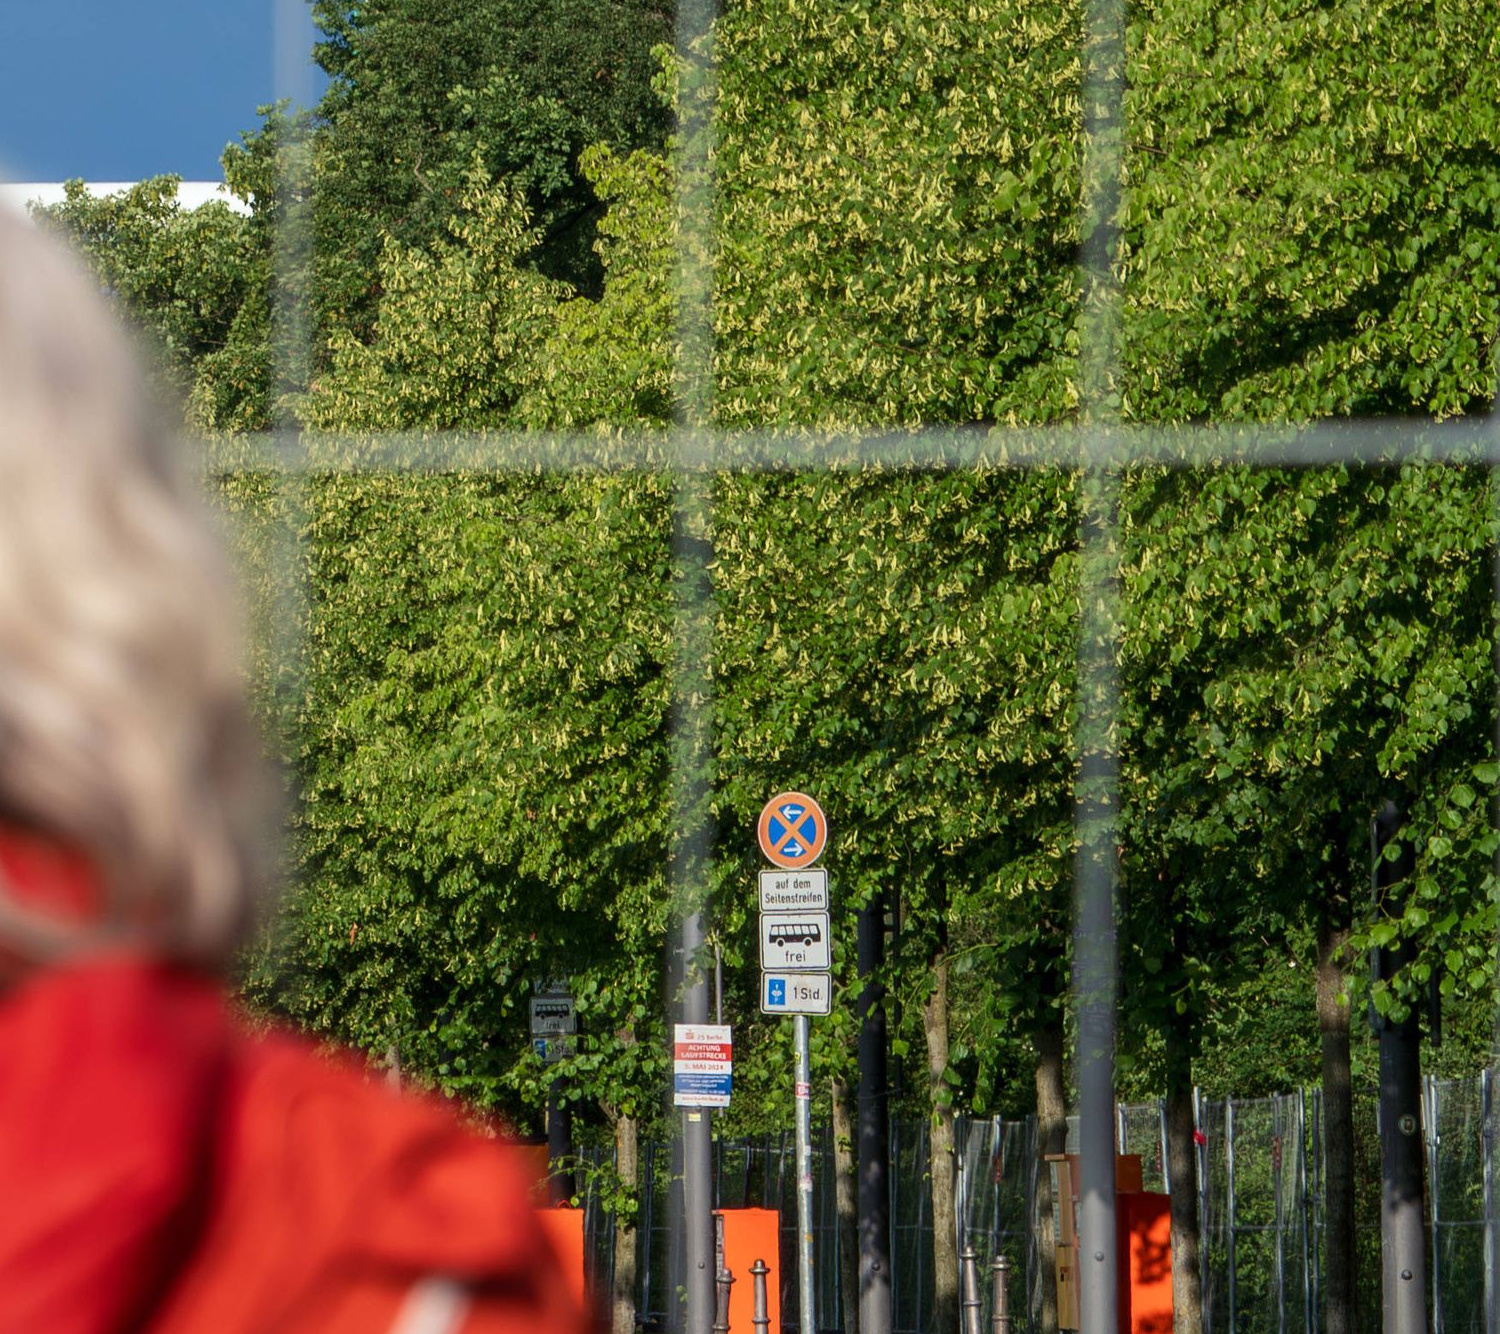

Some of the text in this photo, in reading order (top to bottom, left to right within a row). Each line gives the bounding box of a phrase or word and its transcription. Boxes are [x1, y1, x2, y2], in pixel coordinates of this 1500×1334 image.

[775, 879, 811, 889] auf dem
[765, 892, 823, 904] Seitenstreifen
[785, 950, 806, 962] frei
